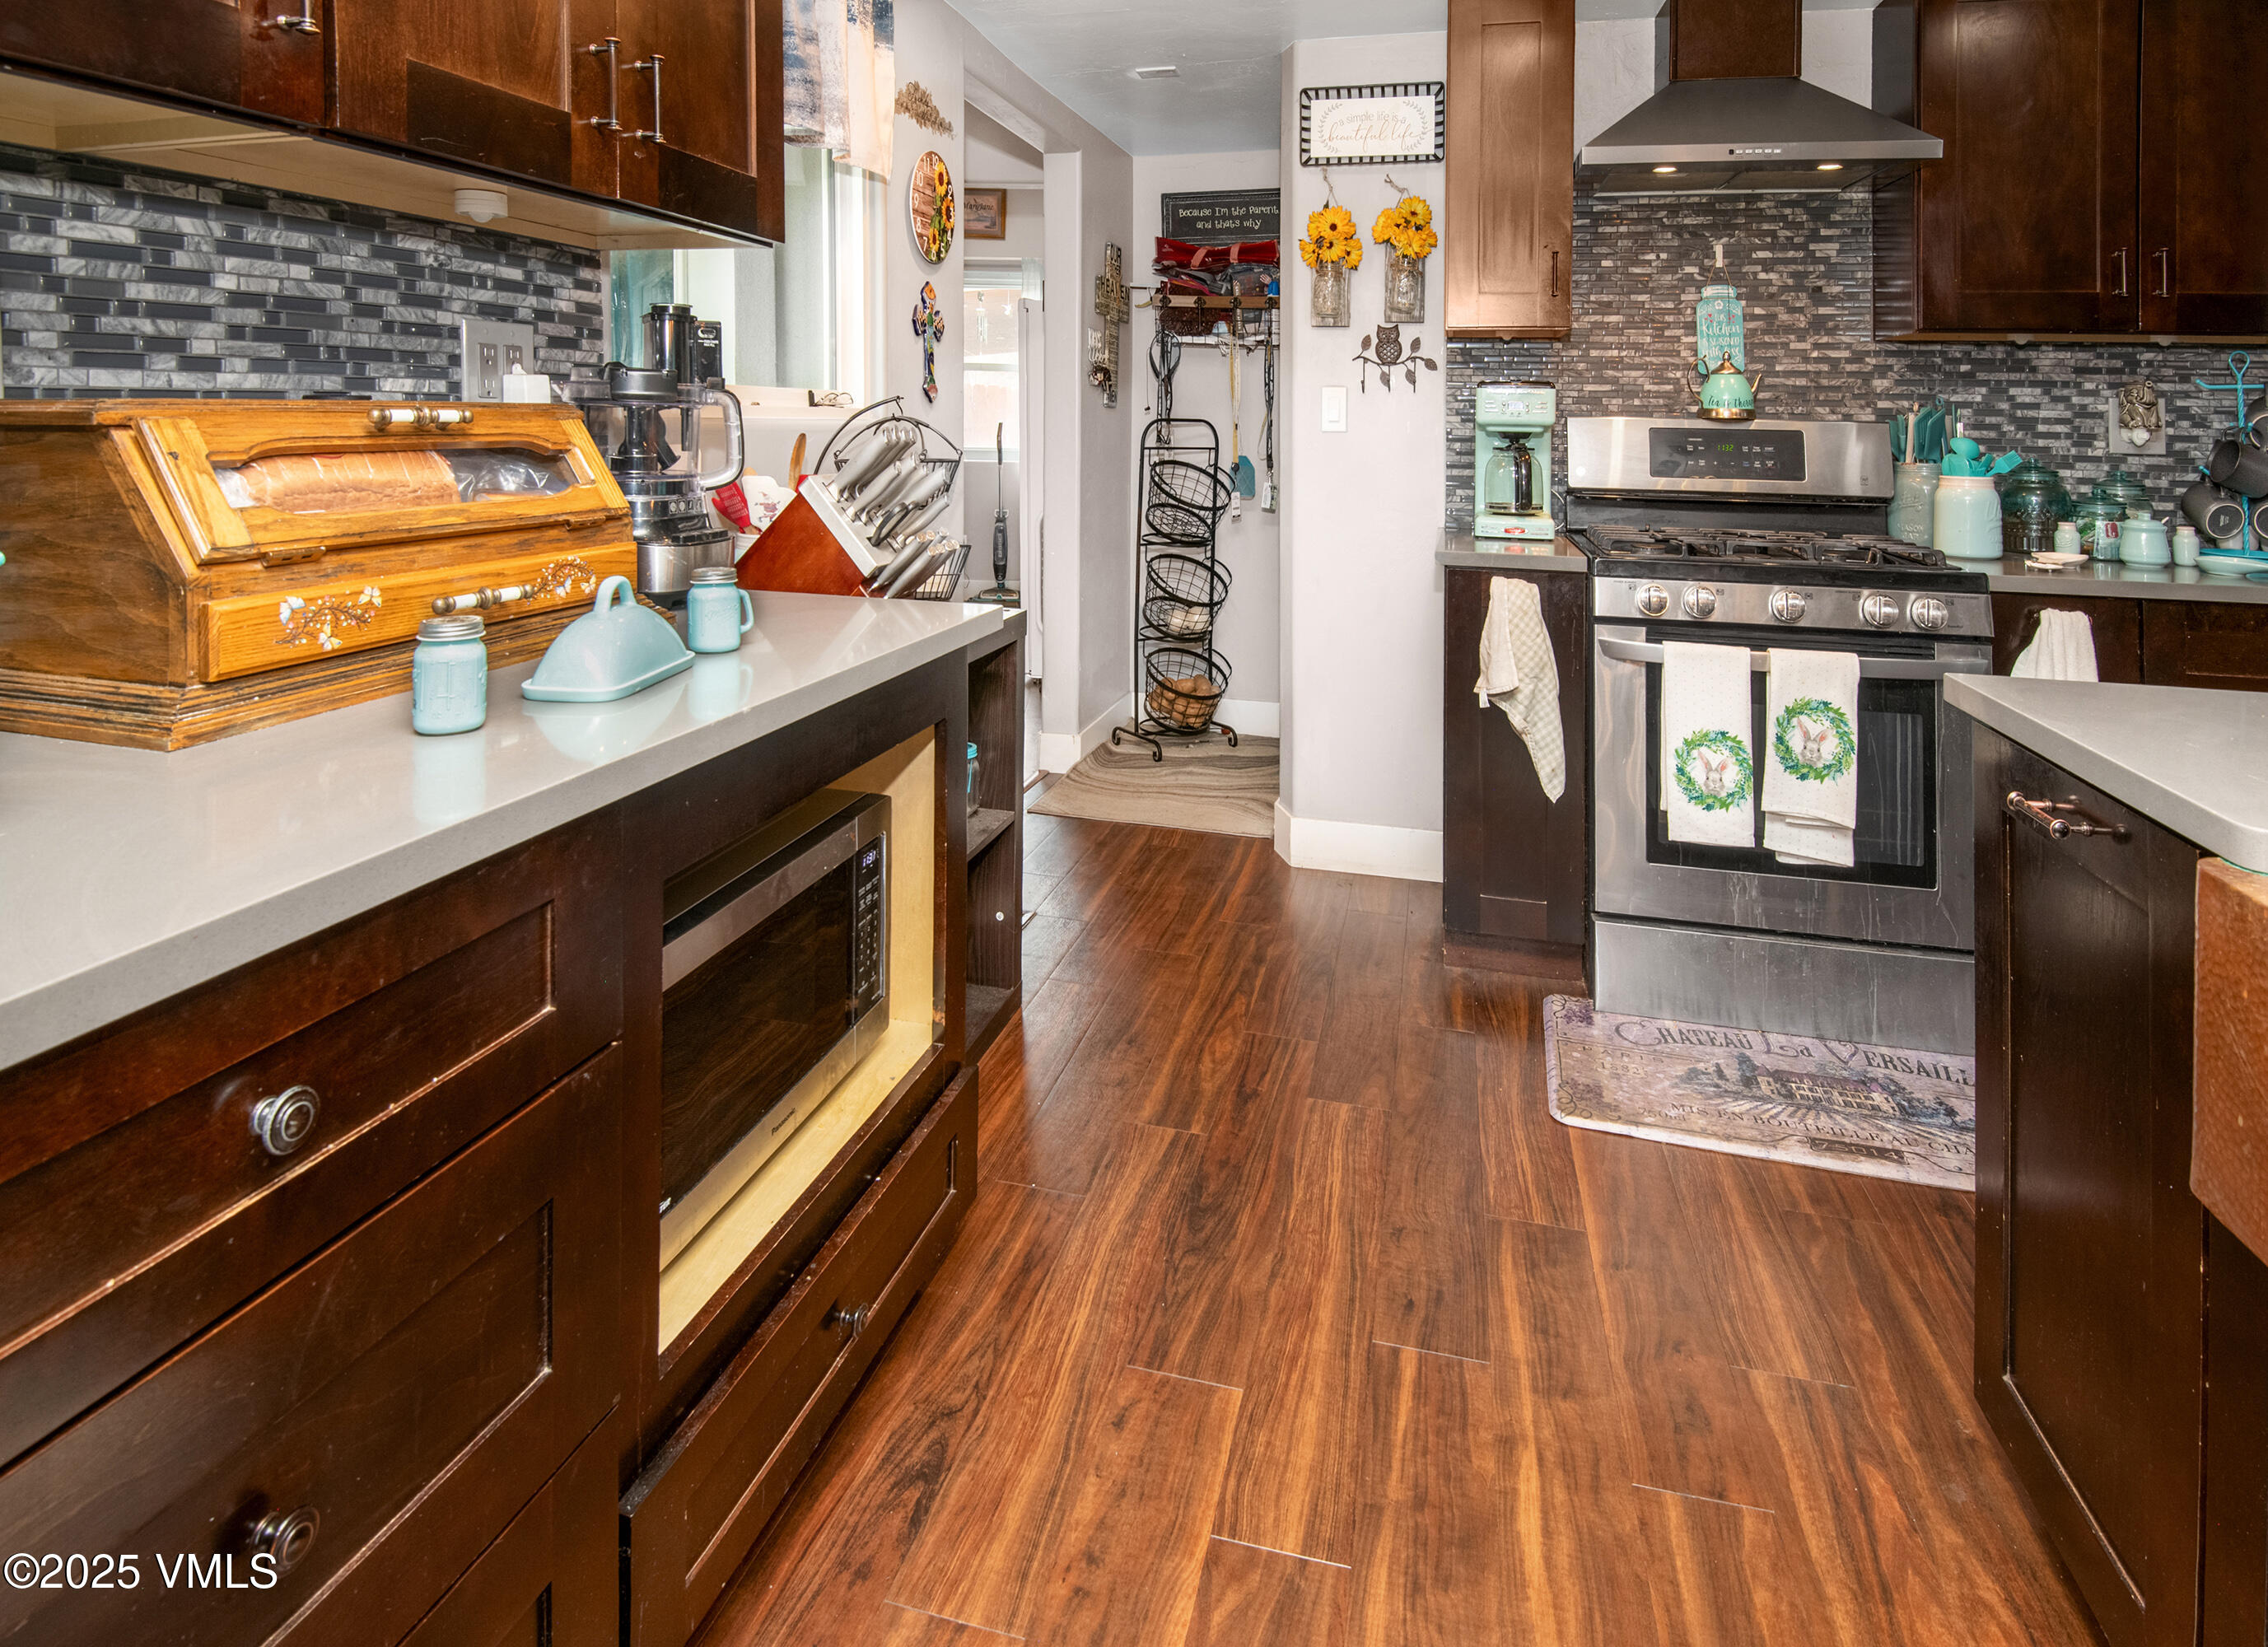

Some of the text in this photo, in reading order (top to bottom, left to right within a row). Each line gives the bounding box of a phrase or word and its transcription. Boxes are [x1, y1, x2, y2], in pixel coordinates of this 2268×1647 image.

[1346, 111, 1374, 124] simple
[1377, 110, 1389, 120] life
[1392, 111, 1398, 121] is
[1324, 119, 1420, 152] beautiful life
[923, 156, 930, 172] 11
[931, 154, 939, 170] 12
[916, 170, 923, 187] 10
[948, 184, 953, 199] 2
[913, 193, 919, 208] 9
[1179, 208, 1211, 217] Because
[1231, 206, 1246, 216] the
[1249, 205, 1279, 215] Parent
[916, 217, 922, 232] 8
[1197, 220, 1211, 229] and
[1244, 218, 1261, 230] why
[923, 236, 928, 252] 7
[940, 242, 945, 258] 5
[931, 248, 936, 261] 6
[1615, 1019, 1752, 1050] CHATEAU
[1752, 1115, 1883, 1143] BOUTEILLE
[1892, 1136, 1920, 1148] AU
